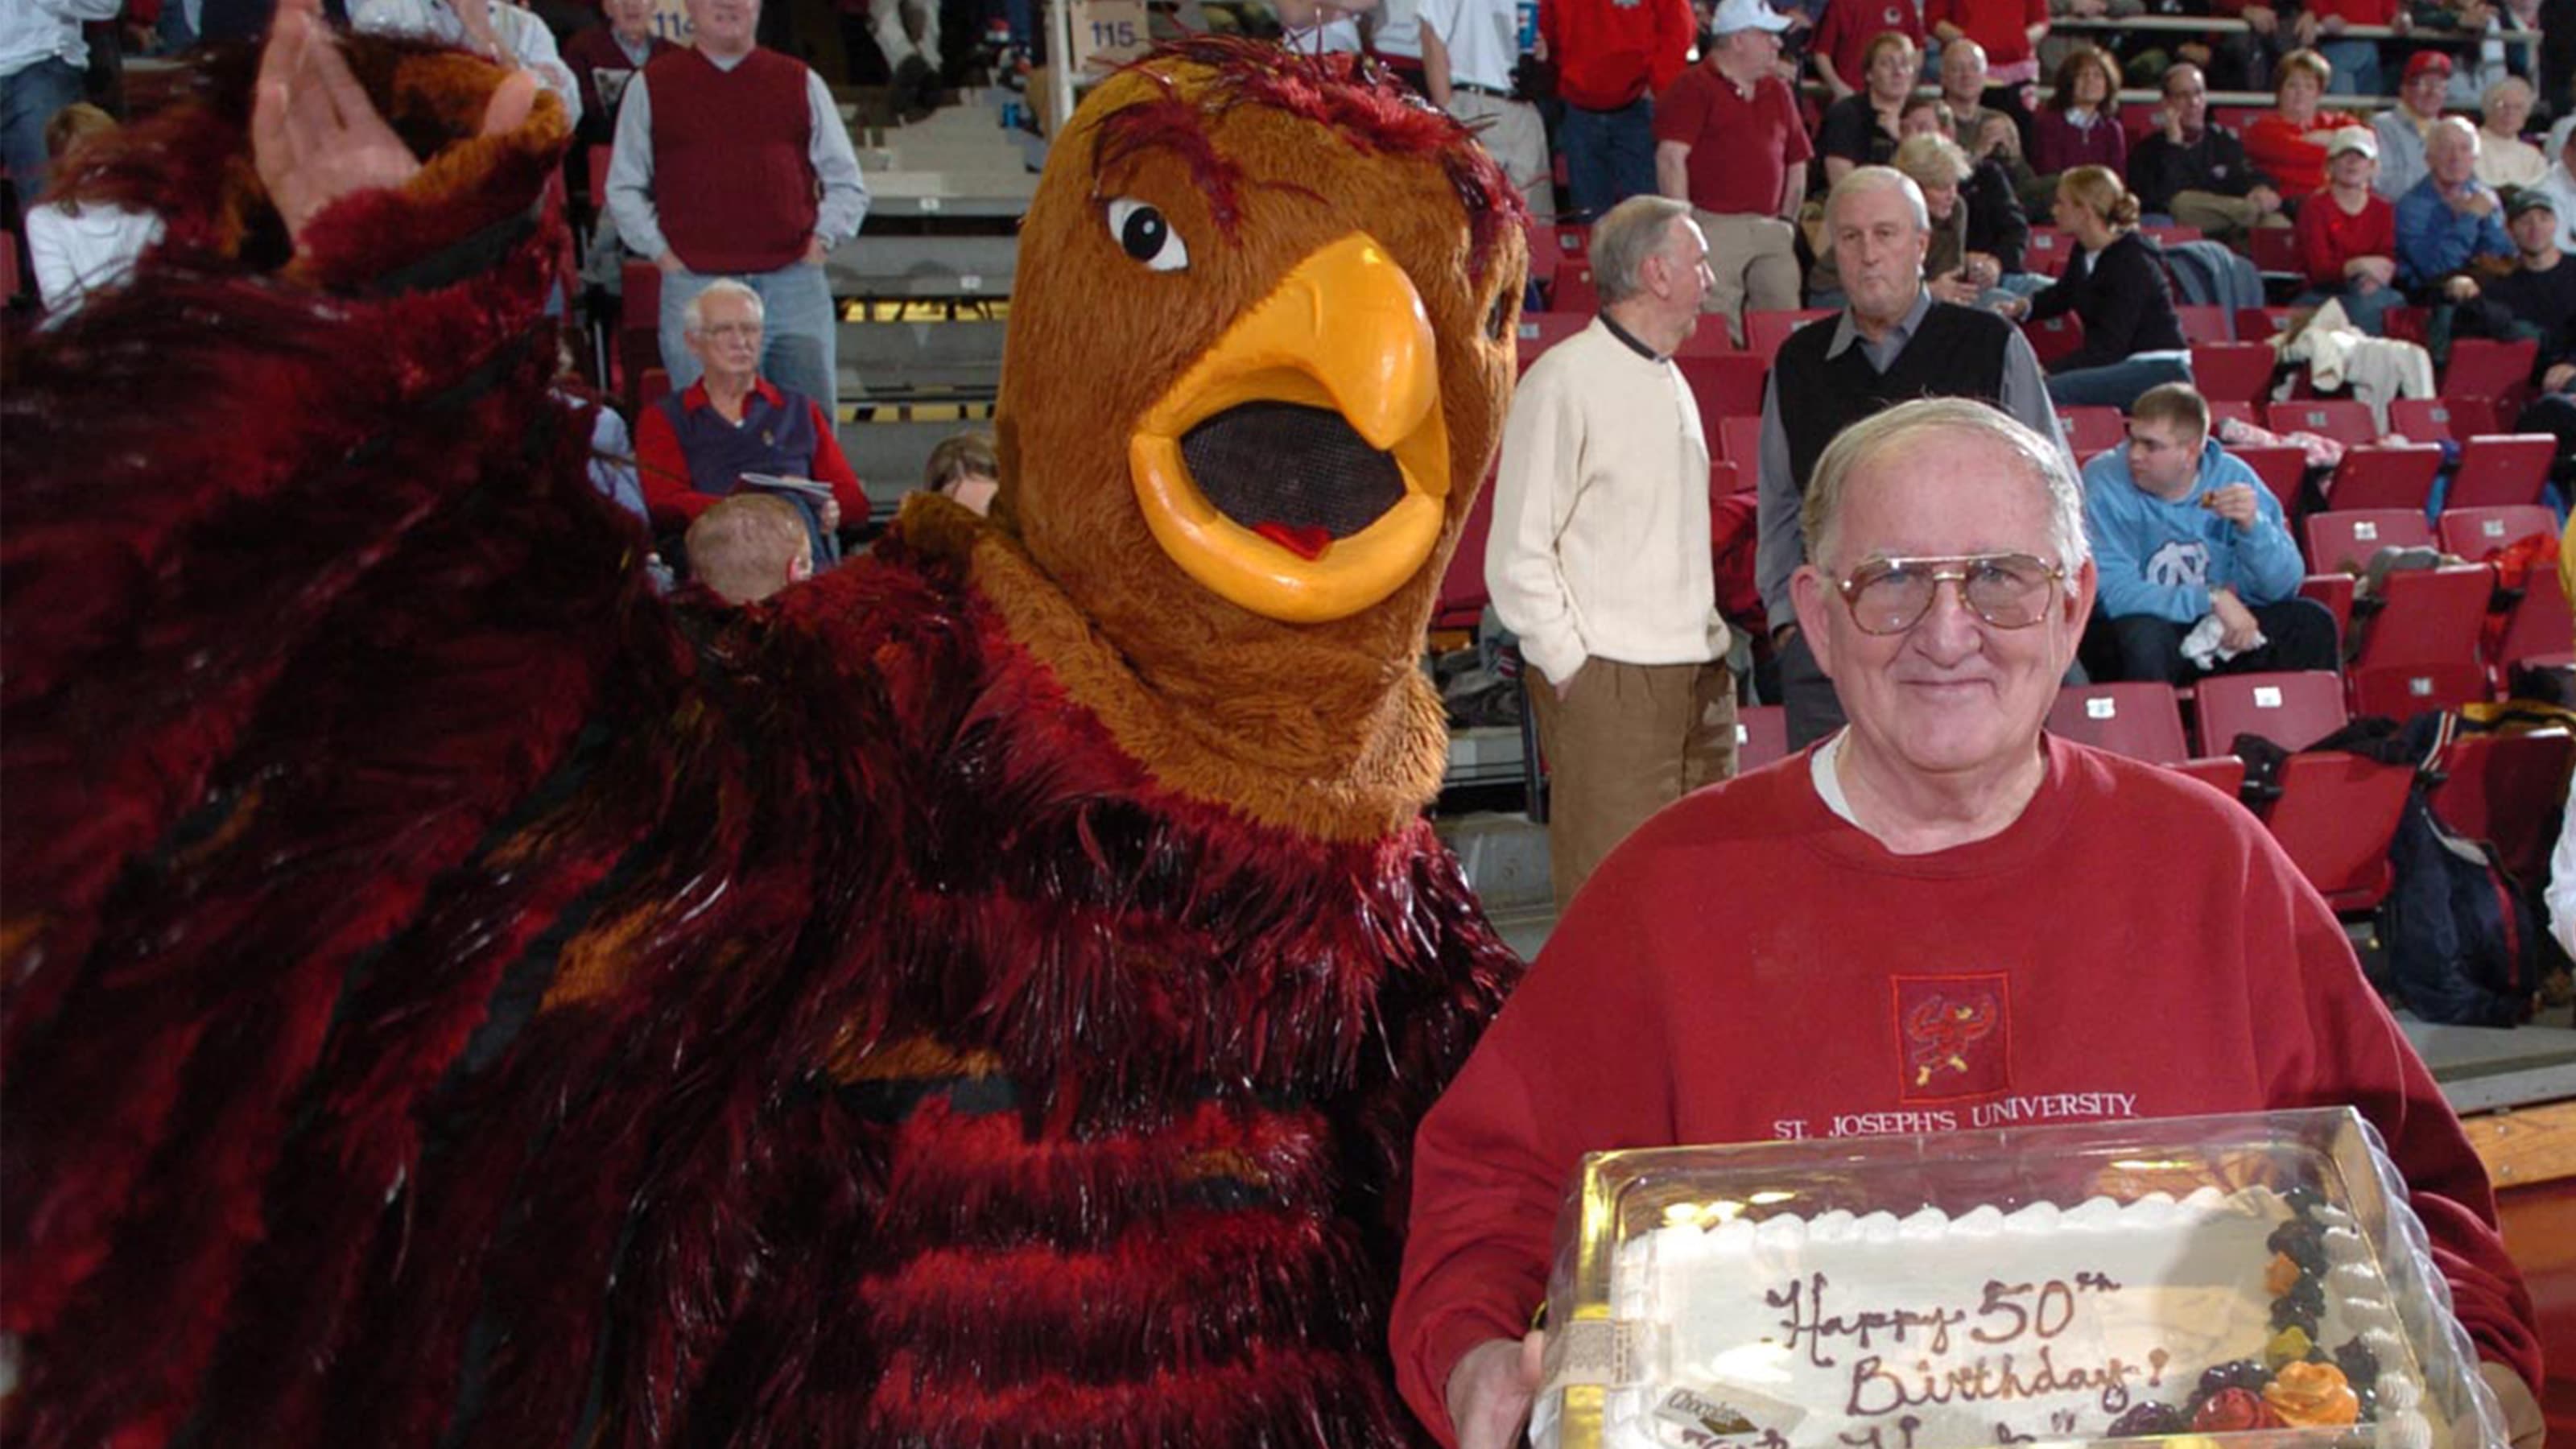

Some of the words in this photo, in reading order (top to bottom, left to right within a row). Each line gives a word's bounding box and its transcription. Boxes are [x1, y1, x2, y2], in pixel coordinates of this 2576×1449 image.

[1091, 21, 1135, 47] 115
[1773, 1120, 1813, 1140] ST.
[1828, 1110, 1957, 1137] JOSEPH'S
[1971, 1092, 2137, 1129] UNIVERSITY
[1766, 1272, 1966, 1367] Happy
